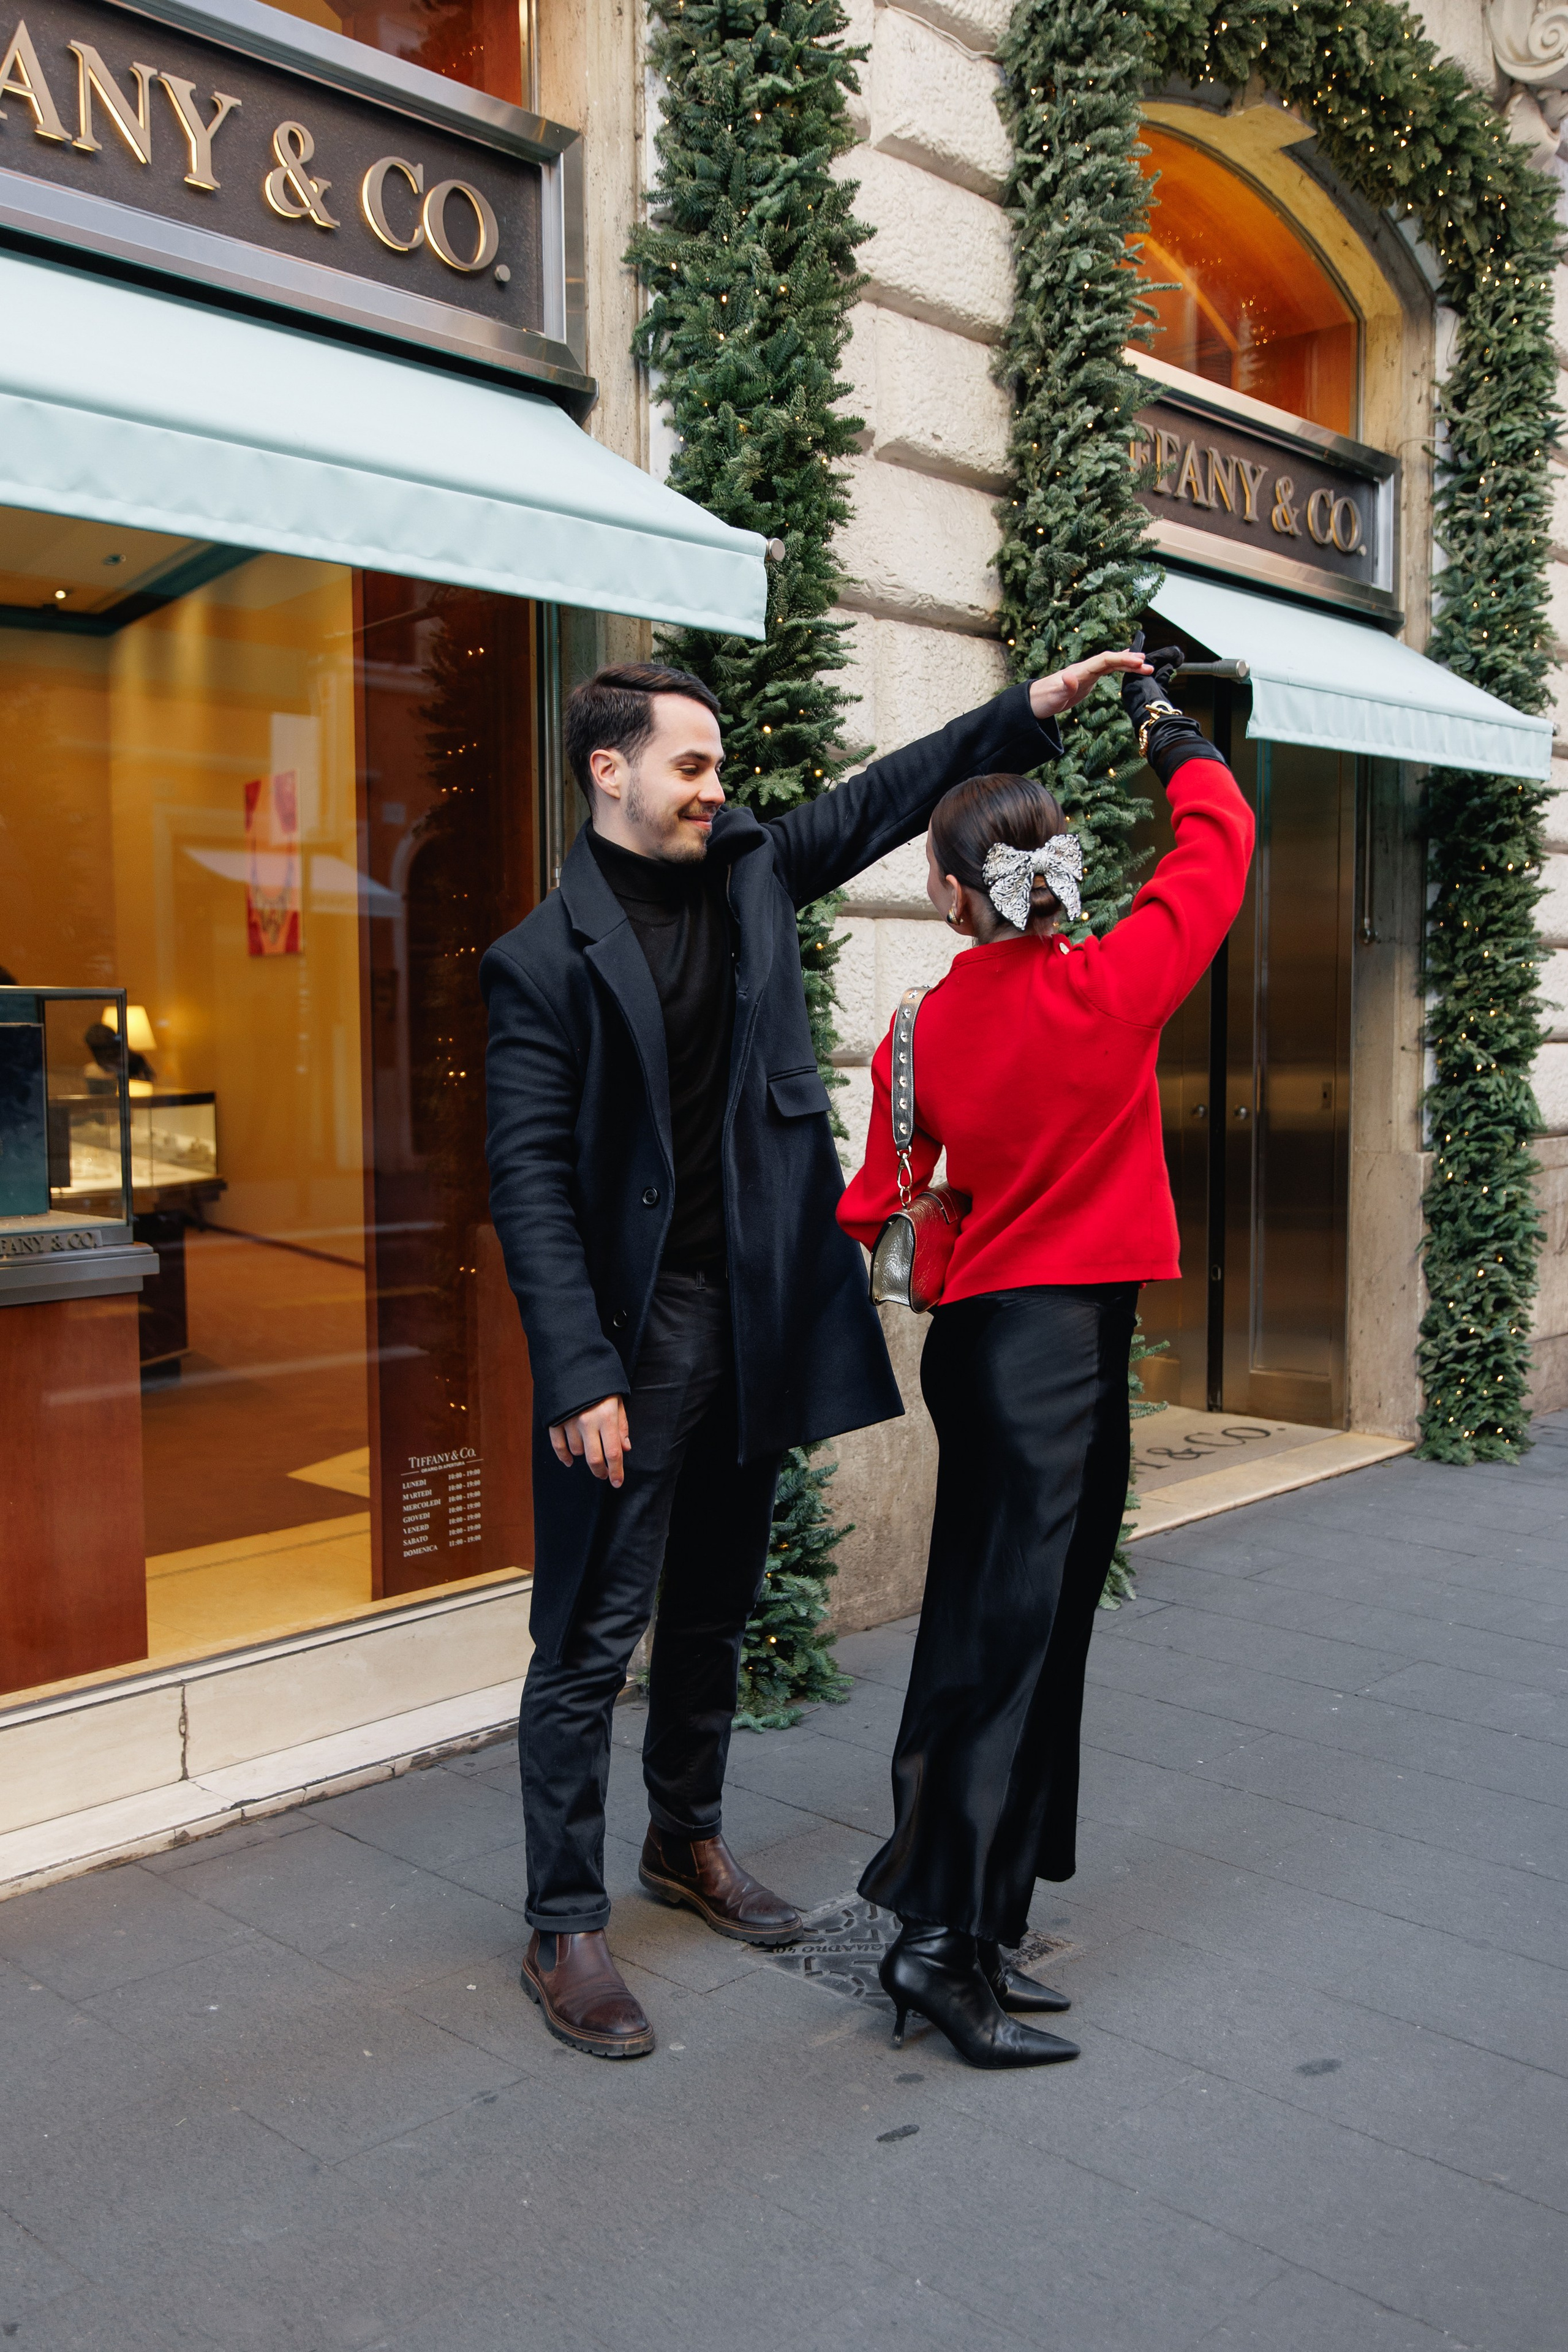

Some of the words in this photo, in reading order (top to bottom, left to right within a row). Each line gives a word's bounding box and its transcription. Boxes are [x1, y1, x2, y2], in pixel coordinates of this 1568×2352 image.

[265, 121, 341, 229] &
[362, 156, 511, 282] CO.
[1272, 476, 1302, 537] &
[1307, 488, 1366, 557] CO.
[50, 1235, 64, 1251] &
[67, 1232, 97, 1249] CO.
[403, 1535, 428, 1546] SABATO
[403, 1545, 438, 1557] DOMENICA
[802, 1943, 883, 1953] QUADRO
